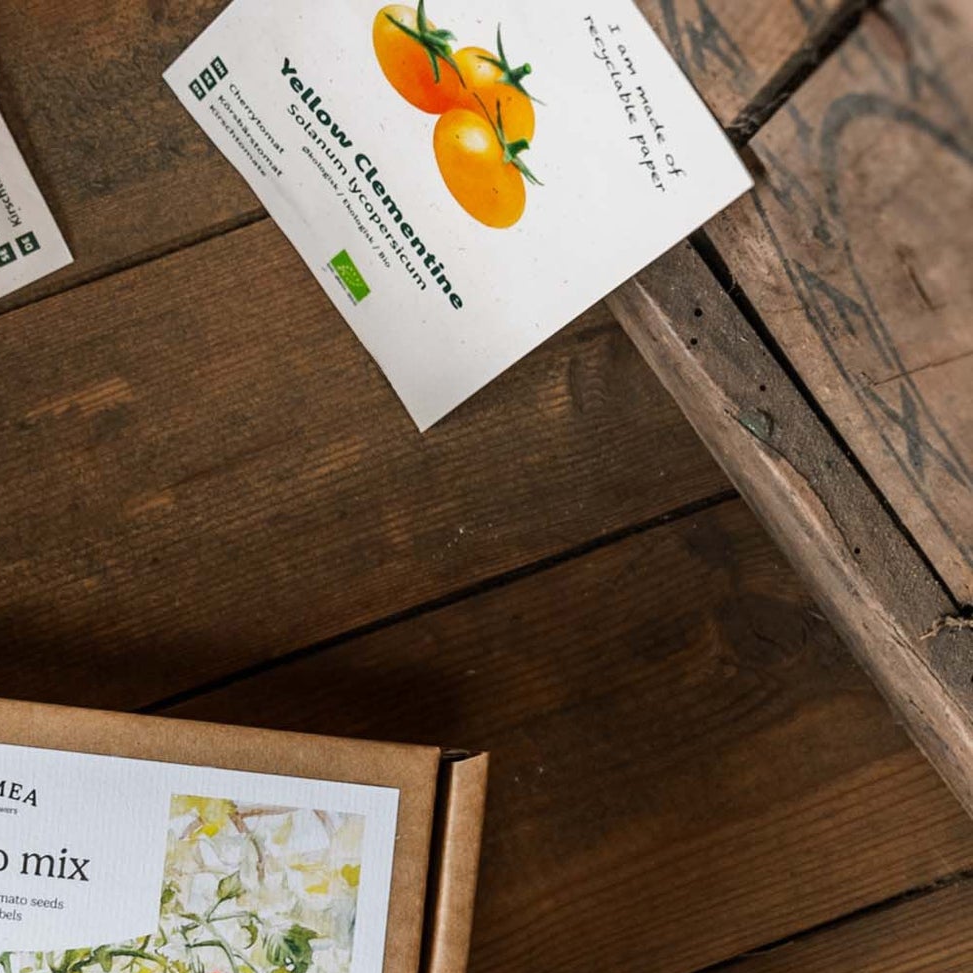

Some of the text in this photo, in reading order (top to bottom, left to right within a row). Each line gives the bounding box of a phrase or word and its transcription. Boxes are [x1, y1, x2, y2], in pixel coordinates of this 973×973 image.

[218, 95, 283, 177] Körsbärstomat
[229, 83, 285, 154] Cherrytomat
[583, 15, 666, 193] recyclable paper
[608, 23, 686, 178] I am made of
[209, 104, 266, 177] Kirschtomate
[280, 57, 464, 310] Yellow Clementine
[286, 103, 348, 177] Solanum
[347, 176, 427, 291] lycopersicum
[378, 251, 391, 268] Bio
[20, 847, 90, 882] mix
[30, 895, 64, 910] seeds
